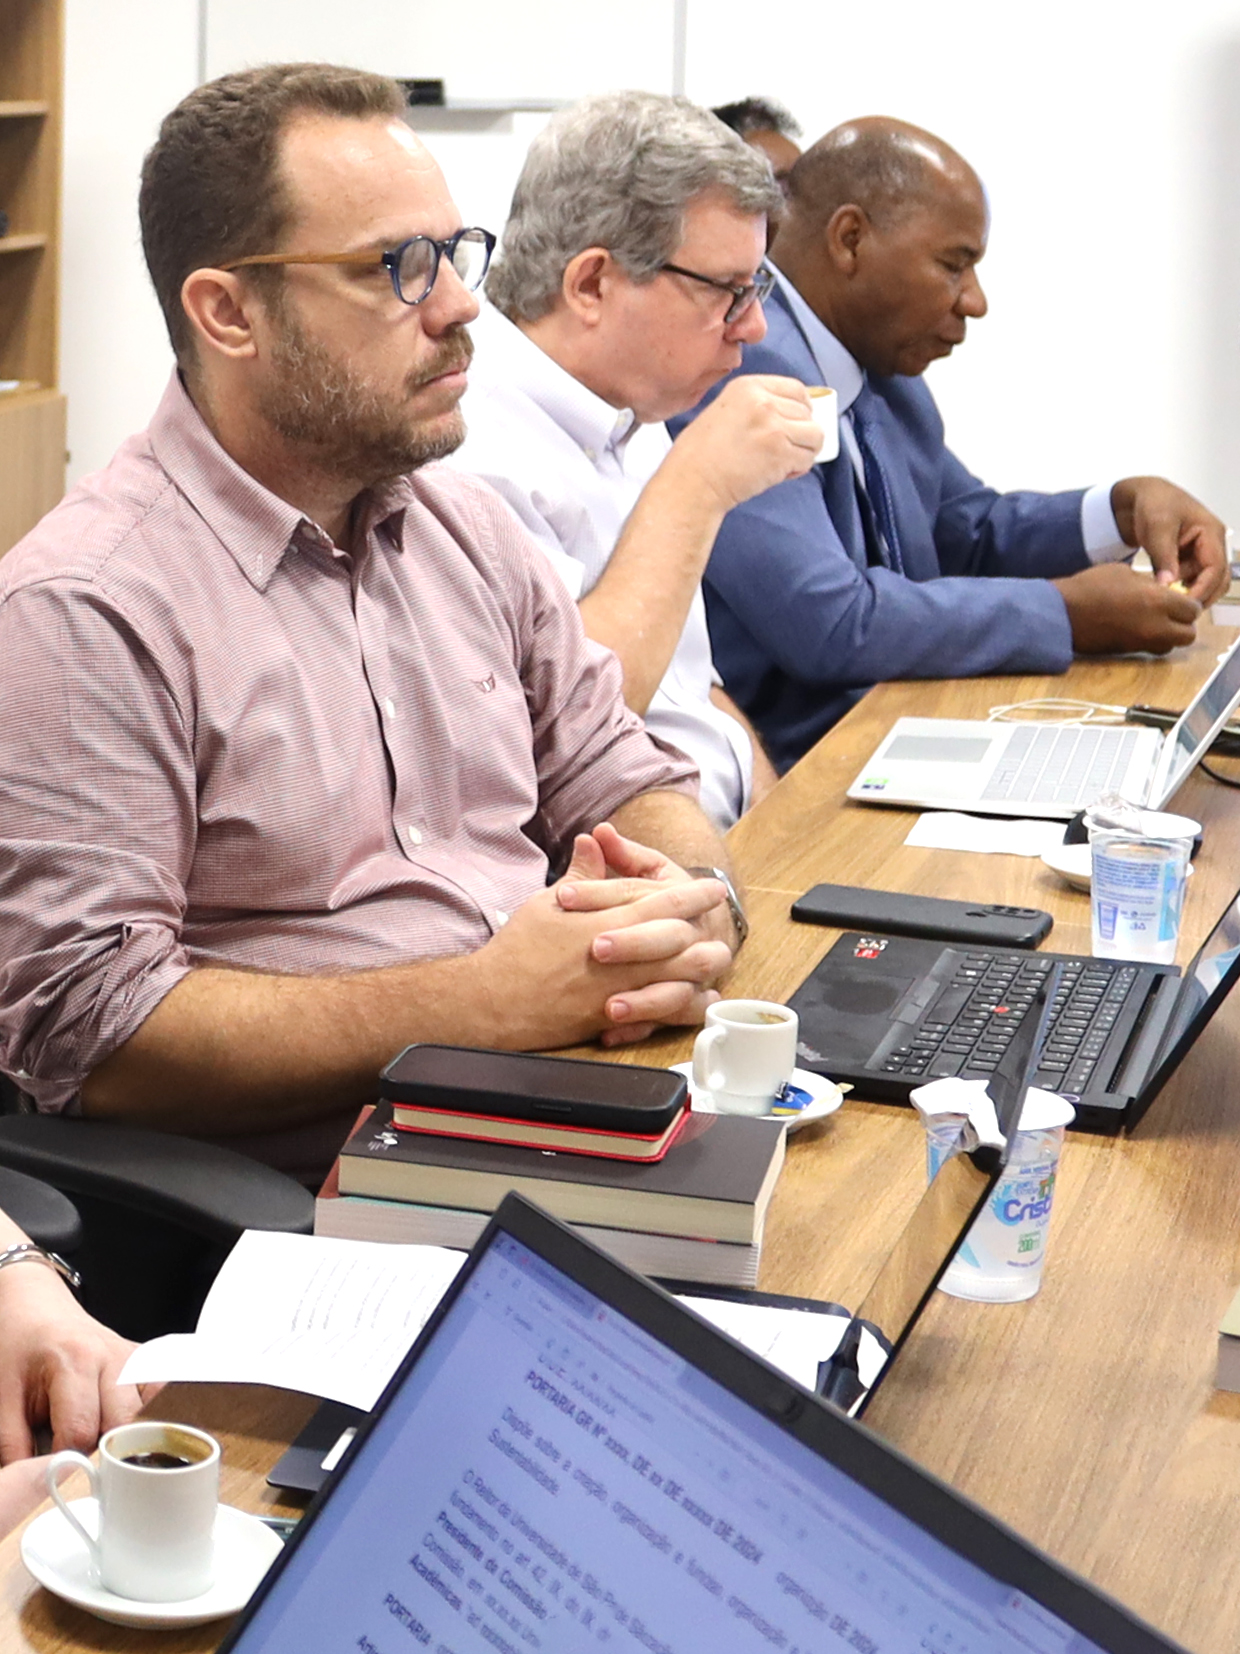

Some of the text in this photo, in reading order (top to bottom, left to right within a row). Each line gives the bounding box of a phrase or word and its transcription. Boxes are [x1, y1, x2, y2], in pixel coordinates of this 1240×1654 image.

[524, 1368, 576, 1417] PORTARIA
[573, 1408, 594, 1431] GR
[630, 1453, 652, 1477] DE
[662, 1478, 684, 1502] DE
[712, 1518, 735, 1543] DE
[435, 1509, 484, 1562] Presidente
[507, 1509, 569, 1570] Universidade
[382, 1591, 431, 1645] PORTARIA
